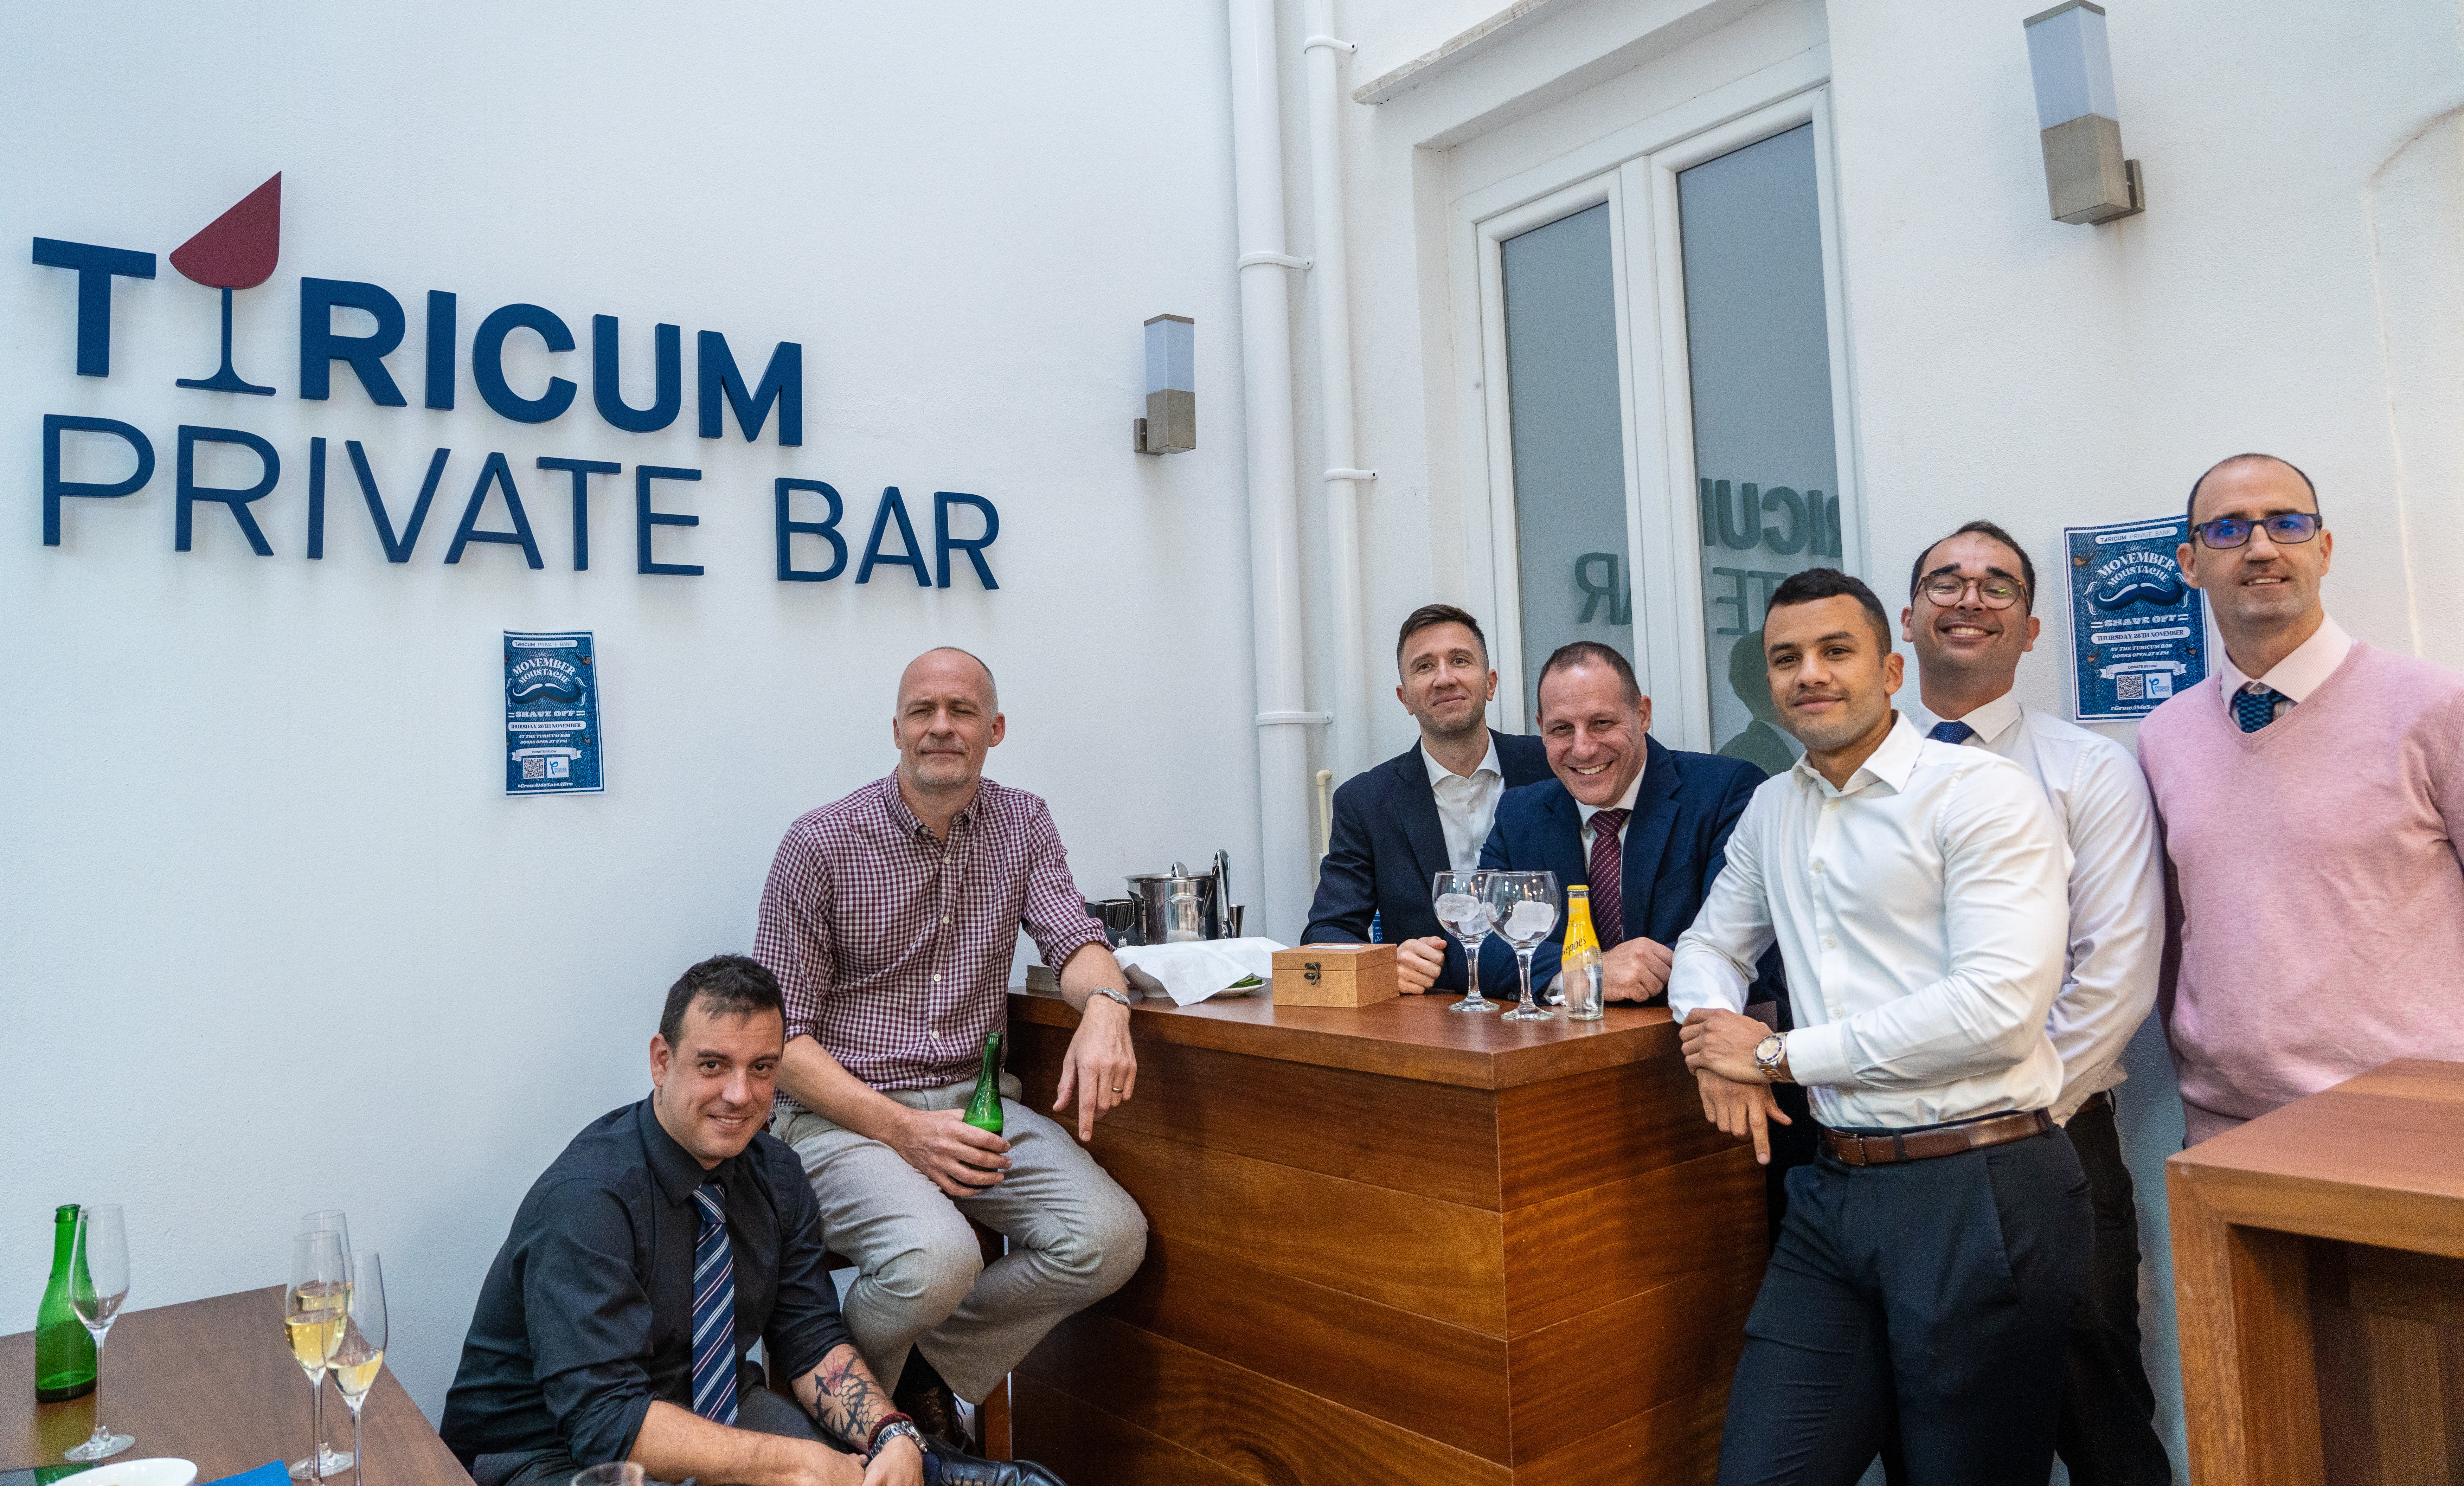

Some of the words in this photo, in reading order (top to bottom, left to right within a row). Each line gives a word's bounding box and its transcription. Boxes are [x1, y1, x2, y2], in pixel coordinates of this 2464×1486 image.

[43, 414, 704, 577] PRIVATE
[775, 477, 1000, 591] BAR
[2097, 552, 2175, 579] MOVEMBER
[2107, 566, 2169, 587] MOUSTACHE
[2104, 617, 2150, 627] SHAVE
[2152, 615, 2176, 623] OFF
[512, 657, 575, 676] MOVEMBER
[518, 669, 570, 684] MOUSTACHE
